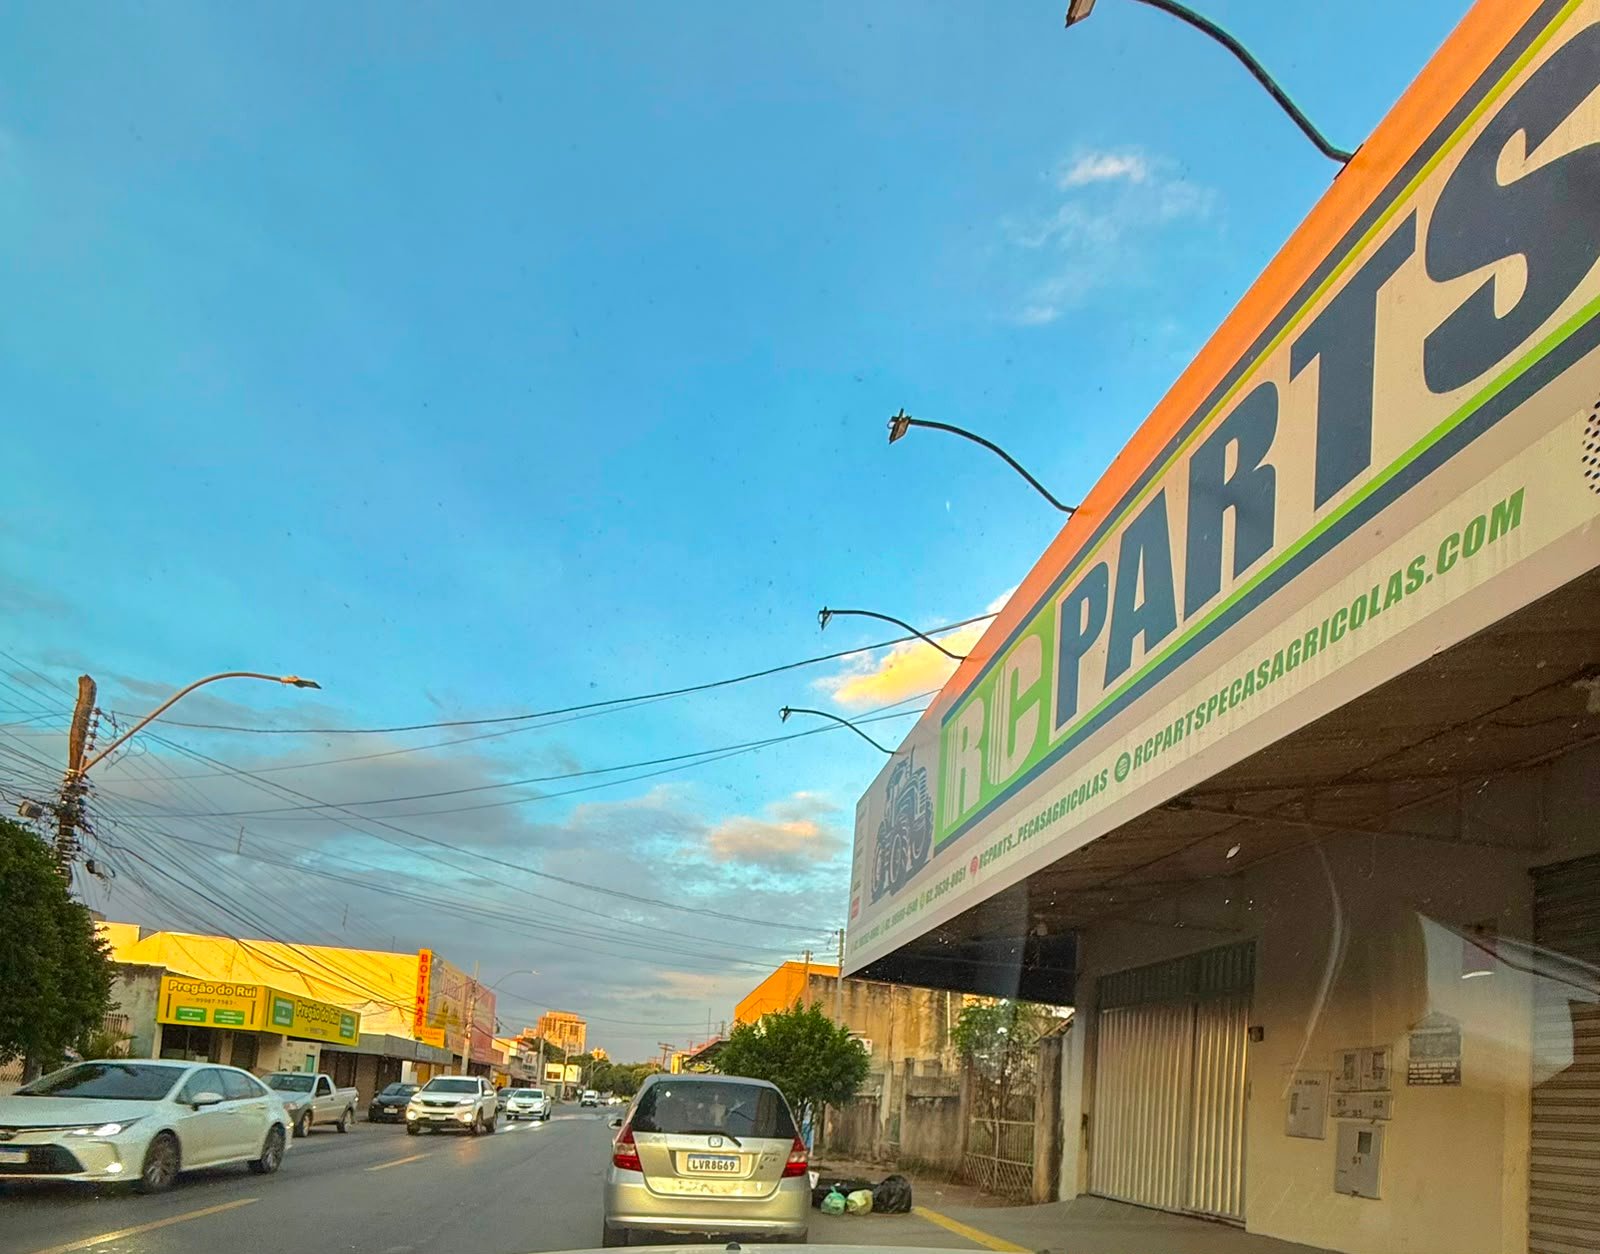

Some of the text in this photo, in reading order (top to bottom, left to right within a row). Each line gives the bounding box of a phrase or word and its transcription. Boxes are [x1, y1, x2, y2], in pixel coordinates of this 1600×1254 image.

[943, 20, 1600, 831] RC PARTS
[1133, 486, 1525, 769] RCPARTSPECASAGRICOLAS.COM
[168, 980, 257, 998] Pregão do Rui
[296, 1000, 320, 1023] Pregão
[321, 1007, 329, 1023] do
[692, 1160, 735, 1170] LVR8G69
